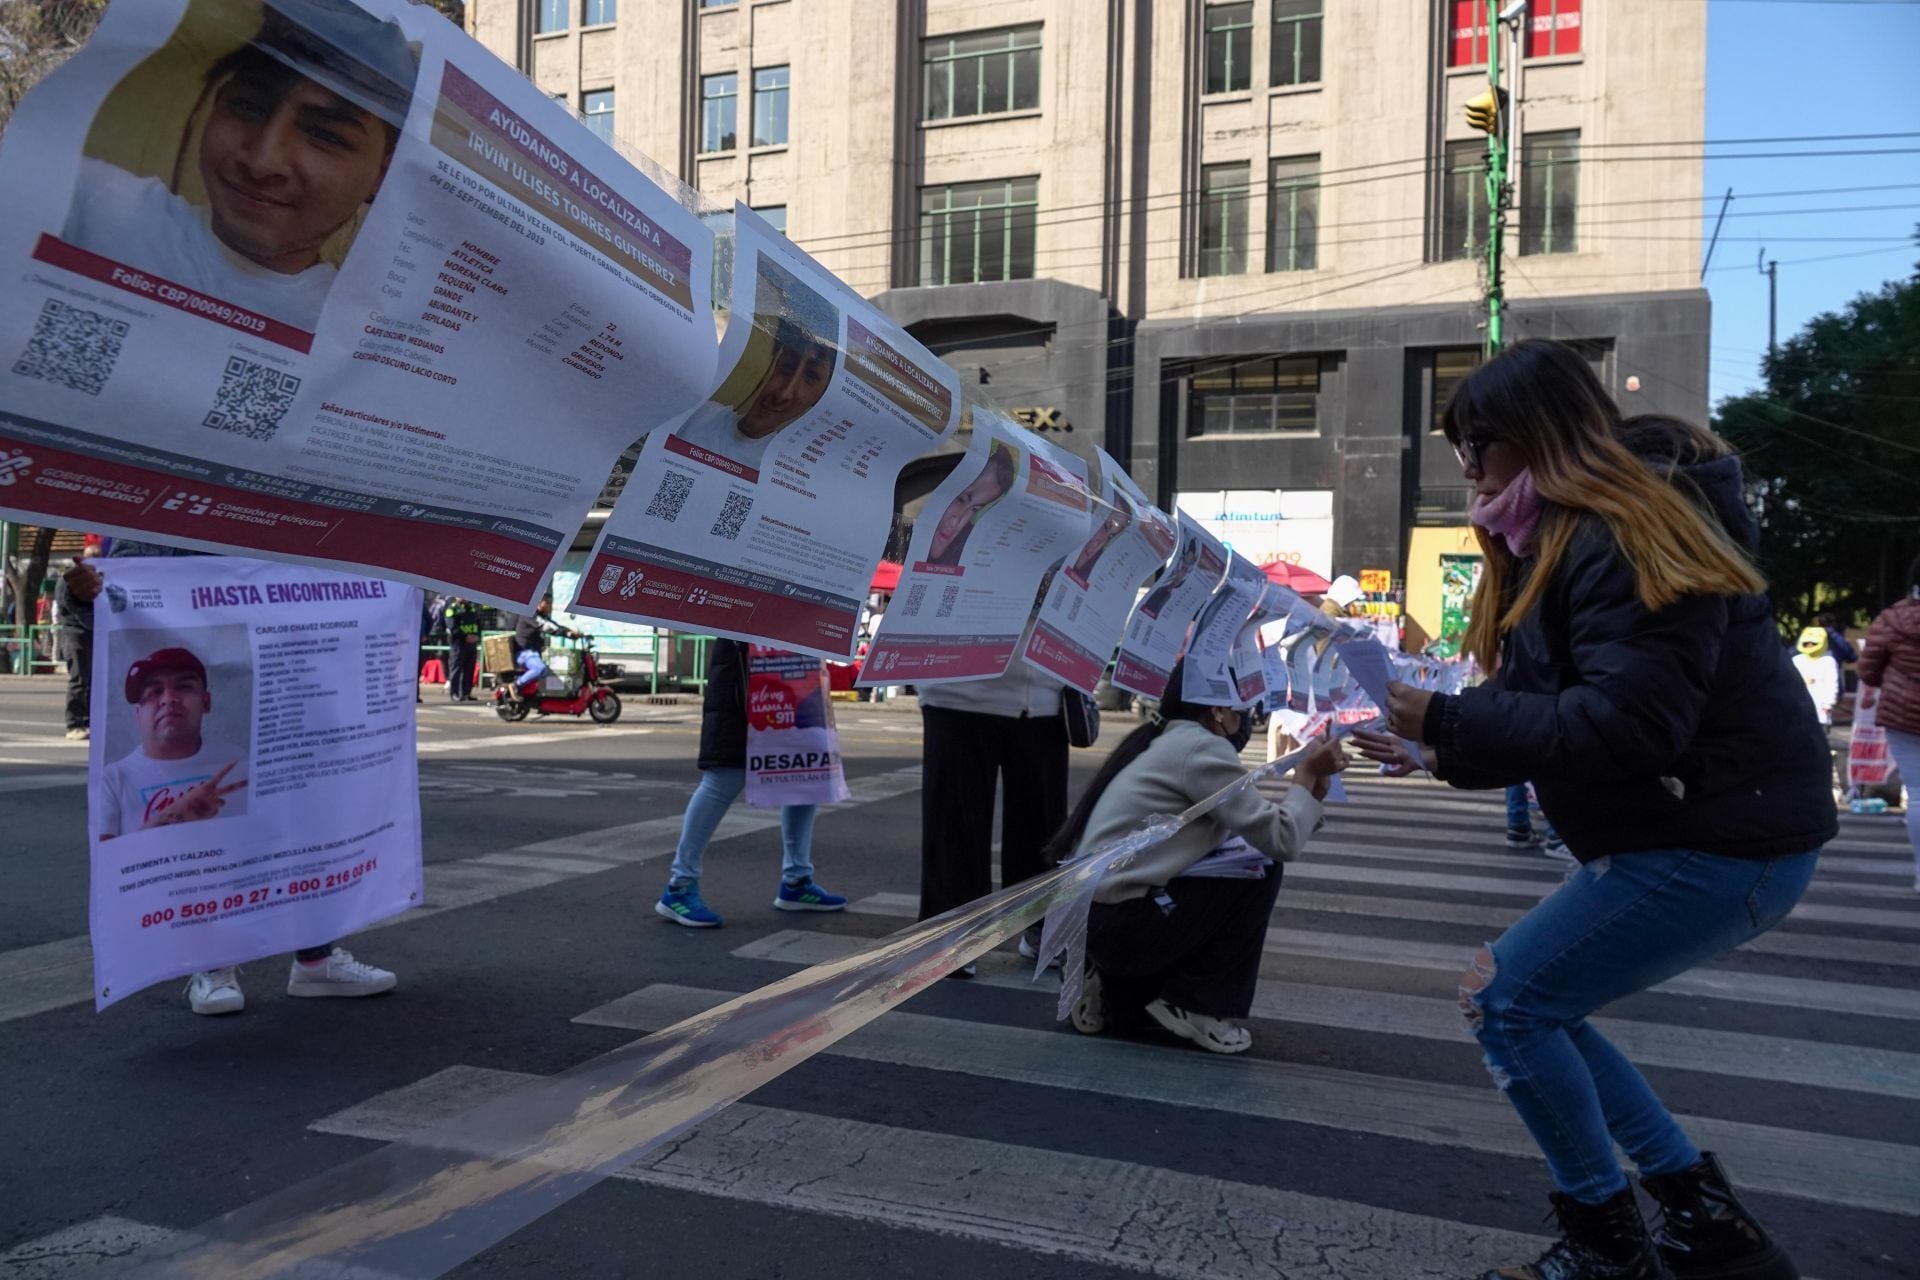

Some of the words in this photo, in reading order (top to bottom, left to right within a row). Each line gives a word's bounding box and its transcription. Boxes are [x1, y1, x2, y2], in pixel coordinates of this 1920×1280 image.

[490, 108, 568, 176] AYÚDANOS
[570, 169, 581, 186] A
[583, 177, 650, 239] LOCALIZAR
[652, 231, 661, 247] A
[429, 174, 442, 185] 04
[442, 181, 456, 194] DE
[456, 189, 509, 226] SEPTIEMBRE
[510, 220, 524, 235] DEL
[526, 229, 545, 246] 2019
[467, 131, 509, 172] IRVIN
[512, 162, 560, 207] ULISES
[563, 198, 612, 242] TORRES
[614, 235, 676, 287] GUTIERREZ
[437, 160, 449, 174] SE
[450, 168, 461, 179] LE
[463, 175, 477, 190] VIO
[478, 185, 496, 200] POR
[497, 196, 526, 220] ULTIMA
[527, 214, 541, 229] VEZ
[542, 223, 552, 235] EN
[553, 229, 569, 246] COL.
[570, 240, 596, 262] PUERTA
[597, 258, 625, 281] GRANDE,
[625, 275, 648, 296] ALVARO
[648, 291, 676, 312] OBREGON
[451, 249, 494, 275] ATLETICA
[461, 240, 501, 265] HOMBRE
[438, 272, 476, 294] PEQUEÑA
[444, 260, 480, 281] MORENA
[481, 278, 509, 296] CLARA
[112, 268, 156, 293] Folio:
[157, 283, 266, 333] CBP/00049/2019
[433, 286, 464, 303] GRANDE
[421, 312, 461, 331] DEPILADAS
[428, 299, 473, 321] ABUNDANTE
[472, 314, 479, 323] Y
[606, 322, 617, 332] 22
[407, 336, 445, 354] MEDIANOS
[580, 344, 604, 361] RECTA
[588, 338, 624, 361] REDONDA
[380, 356, 411, 371] OSCURO
[410, 365, 433, 378] LACIO
[432, 372, 457, 385] CORTO
[561, 357, 602, 380] CUADRADO
[570, 351, 606, 372] GRUESOS
[904, 364, 934, 391] LOCALIZAR
[320, 401, 343, 414] Señas
[344, 408, 390, 427] particulares
[402, 423, 447, 440] Vestimentas:
[34, 476, 82, 491] CIUDAD
[81, 485, 98, 495] DE
[98, 489, 145, 504] MÉXICO
[42, 468, 115, 488] GOBIERNO
[114, 482, 134, 493] DE
[134, 487, 151, 496] LA
[209, 509, 225, 518] DE
[224, 512, 276, 527] PERSONAS
[216, 503, 268, 517] COMISIÓN
[266, 511, 281, 520] DE
[280, 513, 329, 528] BÚSQUEDA
[470, 549, 494, 562] CIUDAD
[493, 555, 535, 574] INNOVADORA
[487, 564, 522, 580] DERECHOS
[191, 585, 263, 610] ¡HASTA
[265, 580, 388, 604] ENCONTRARLE!
[255, 624, 289, 635] CARLOS
[290, 622, 318, 633] CHAVEZ
[752, 704, 782, 713] LLAMA
[775, 711, 795, 724] 911
[120, 856, 170, 875] VESTIMENTA
[180, 848, 226, 861] CALZADO:
[141, 907, 175, 928] 800
[181, 901, 217, 918] 509
[223, 894, 244, 910] 09
[249, 887, 269, 904] 27
[288, 878, 320, 895] 800
[325, 869, 350, 888] 216
